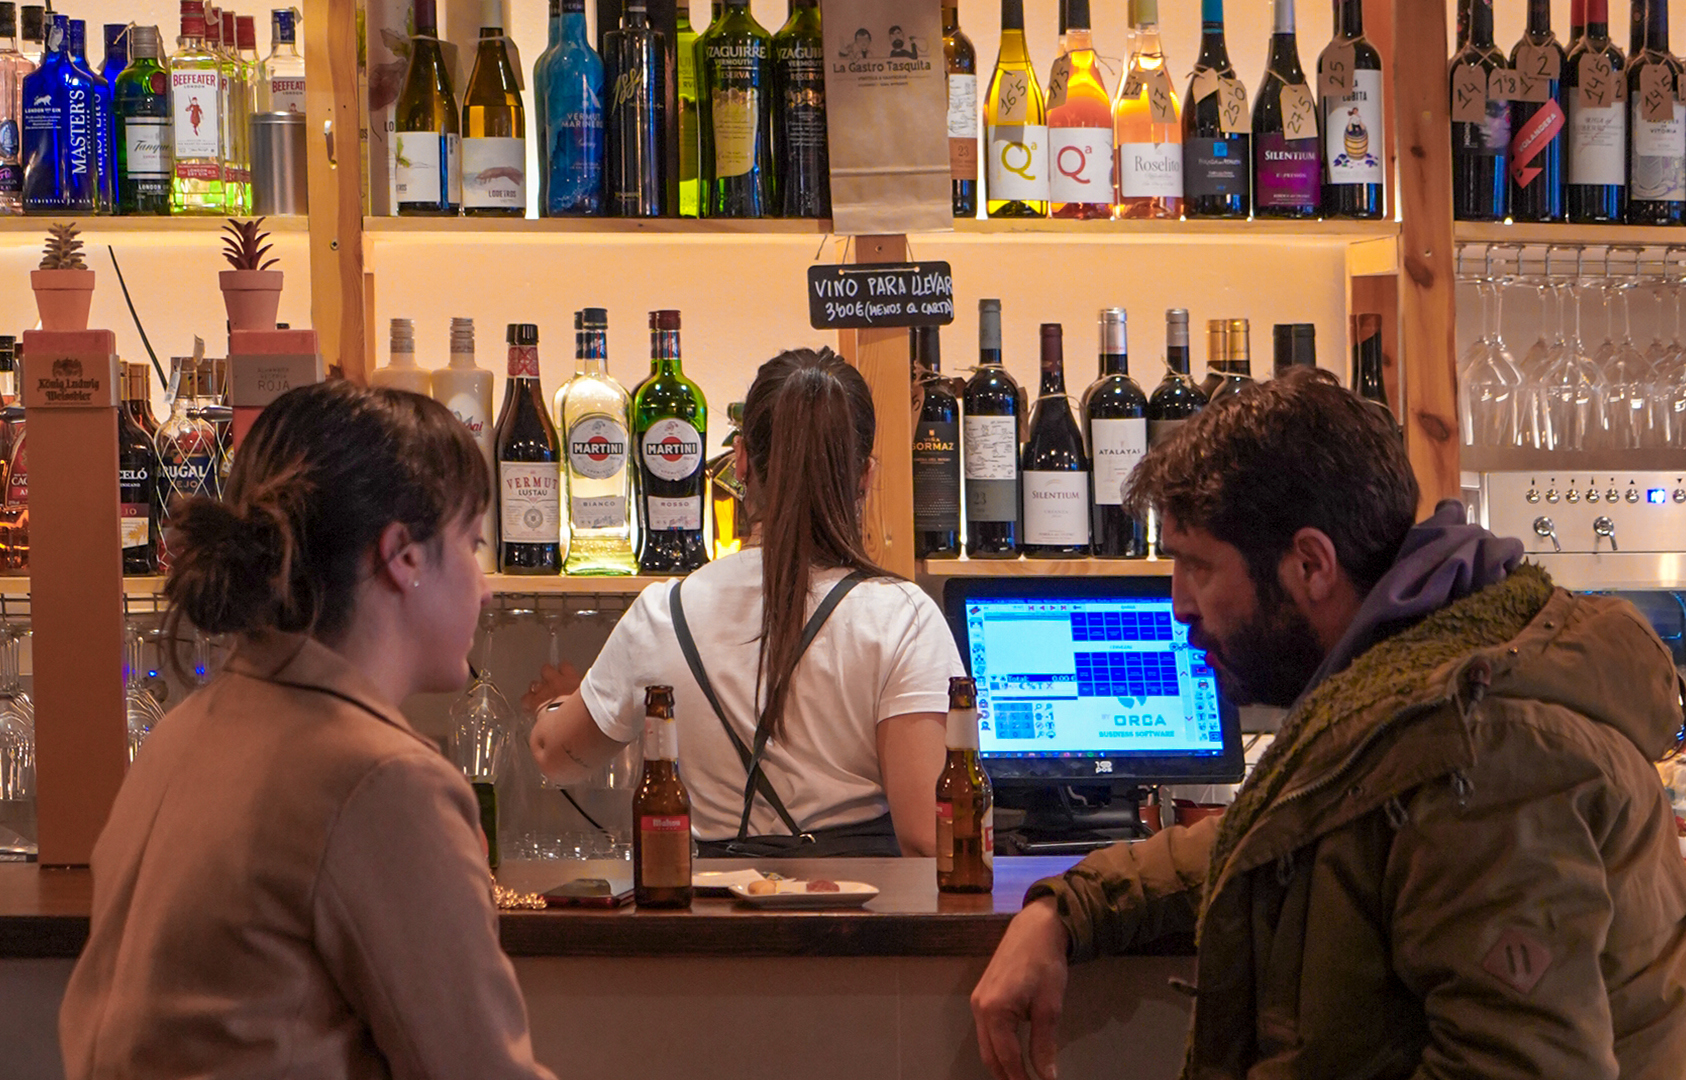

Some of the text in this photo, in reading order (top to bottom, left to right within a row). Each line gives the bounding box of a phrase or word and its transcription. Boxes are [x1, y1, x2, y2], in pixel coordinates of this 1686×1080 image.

[833, 59, 931, 73] La Gastro Tasquita
[173, 73, 216, 87] BEEFEATER
[719, 71, 751, 80] ESERVA
[1329, 60, 1344, 88] 25
[1001, 79, 1027, 116] 16'5
[1457, 82, 1481, 110] 14
[567, 113, 600, 121] VERMUT
[1287, 95, 1312, 134] 27'5
[69, 89, 87, 176] MASTER'S
[1519, 113, 1557, 152] VOLANDERA
[958, 145, 969, 157] 23
[1264, 150, 1316, 161] SILENTIUM
[1135, 155, 1181, 172] Roselito
[815, 271, 953, 298] VINO PARA LLEVAR
[66, 377, 100, 392] Ludwig
[257, 380, 290, 392] ROJA
[573, 443, 623, 454] MARTINI
[647, 443, 697, 454] MARTINI
[506, 476, 558, 490] VERMUT
[973, 492, 987, 505] 23
[1032, 490, 1080, 499] SILENTIUM
[1113, 713, 1167, 727] ORCA
[1098, 730, 1175, 738] BUSINESS SOFTWARE
